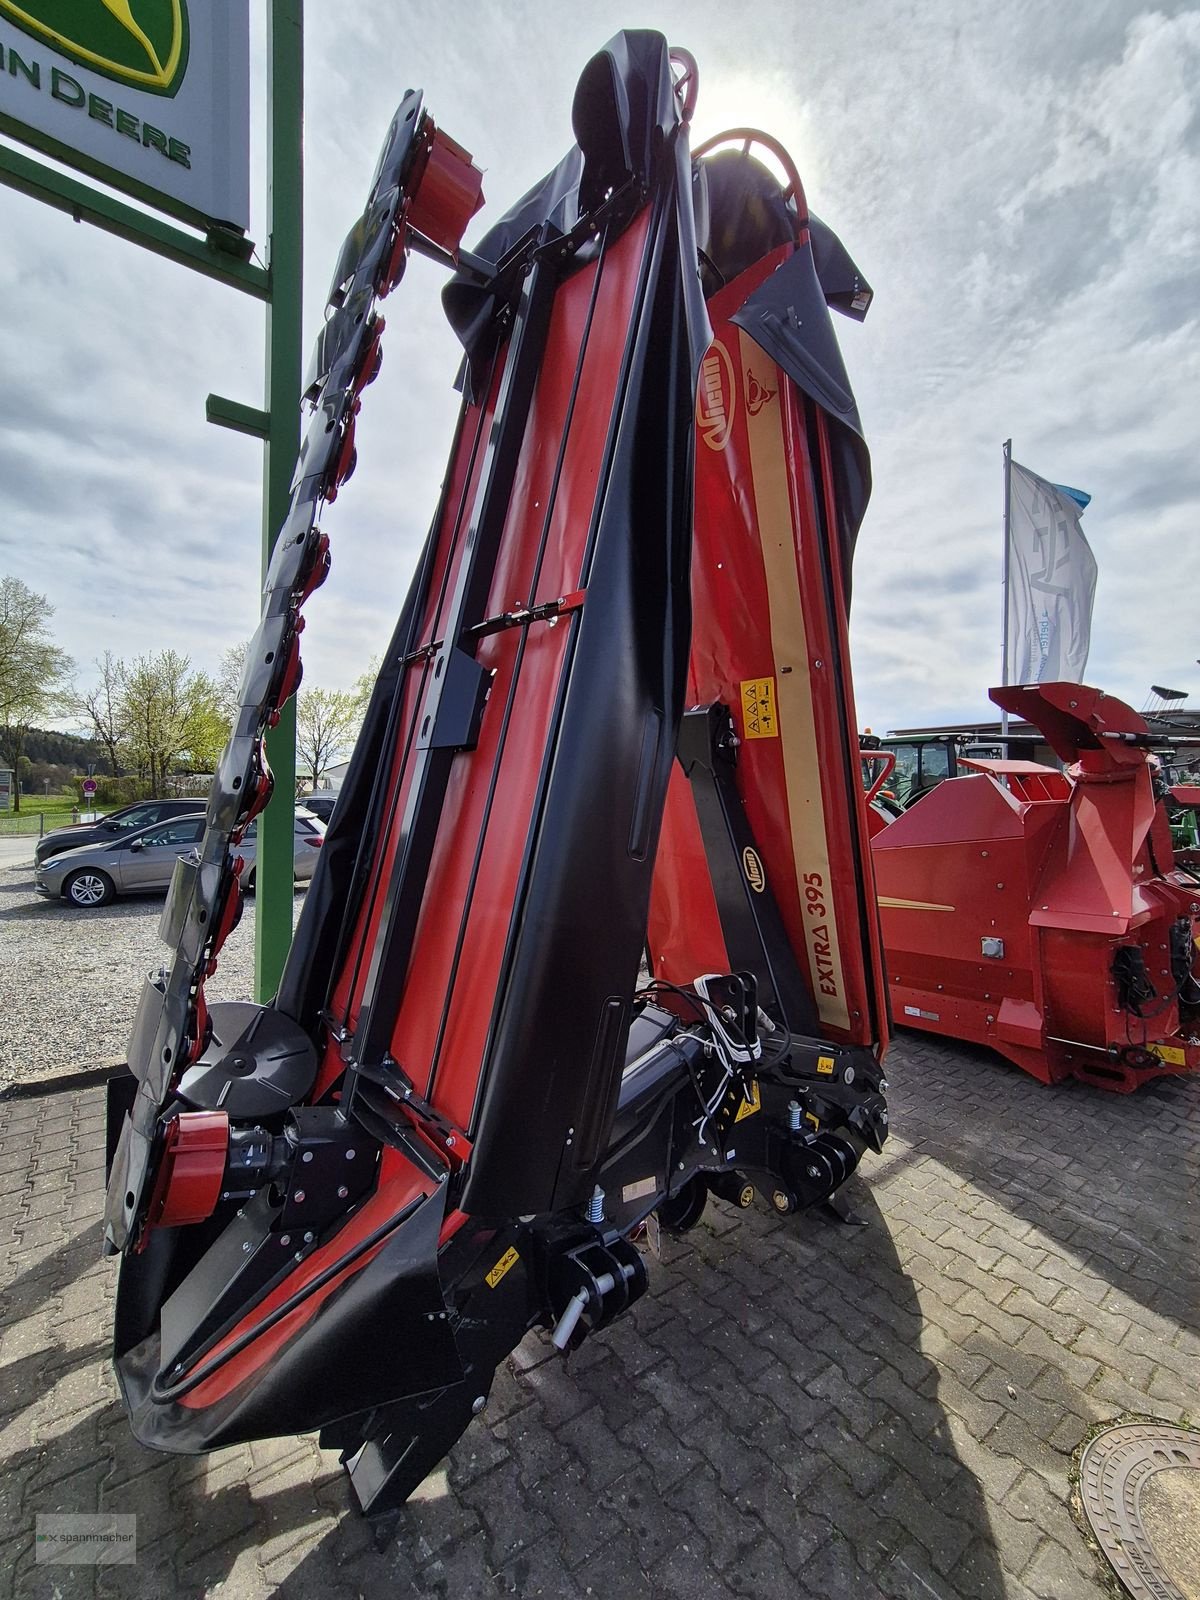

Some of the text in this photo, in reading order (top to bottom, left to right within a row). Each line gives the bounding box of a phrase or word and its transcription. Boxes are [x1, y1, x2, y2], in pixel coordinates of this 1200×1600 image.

[0, 42, 192, 169] N DEERE
[743, 846, 765, 892] Vicon
[803, 872, 826, 918] 395
